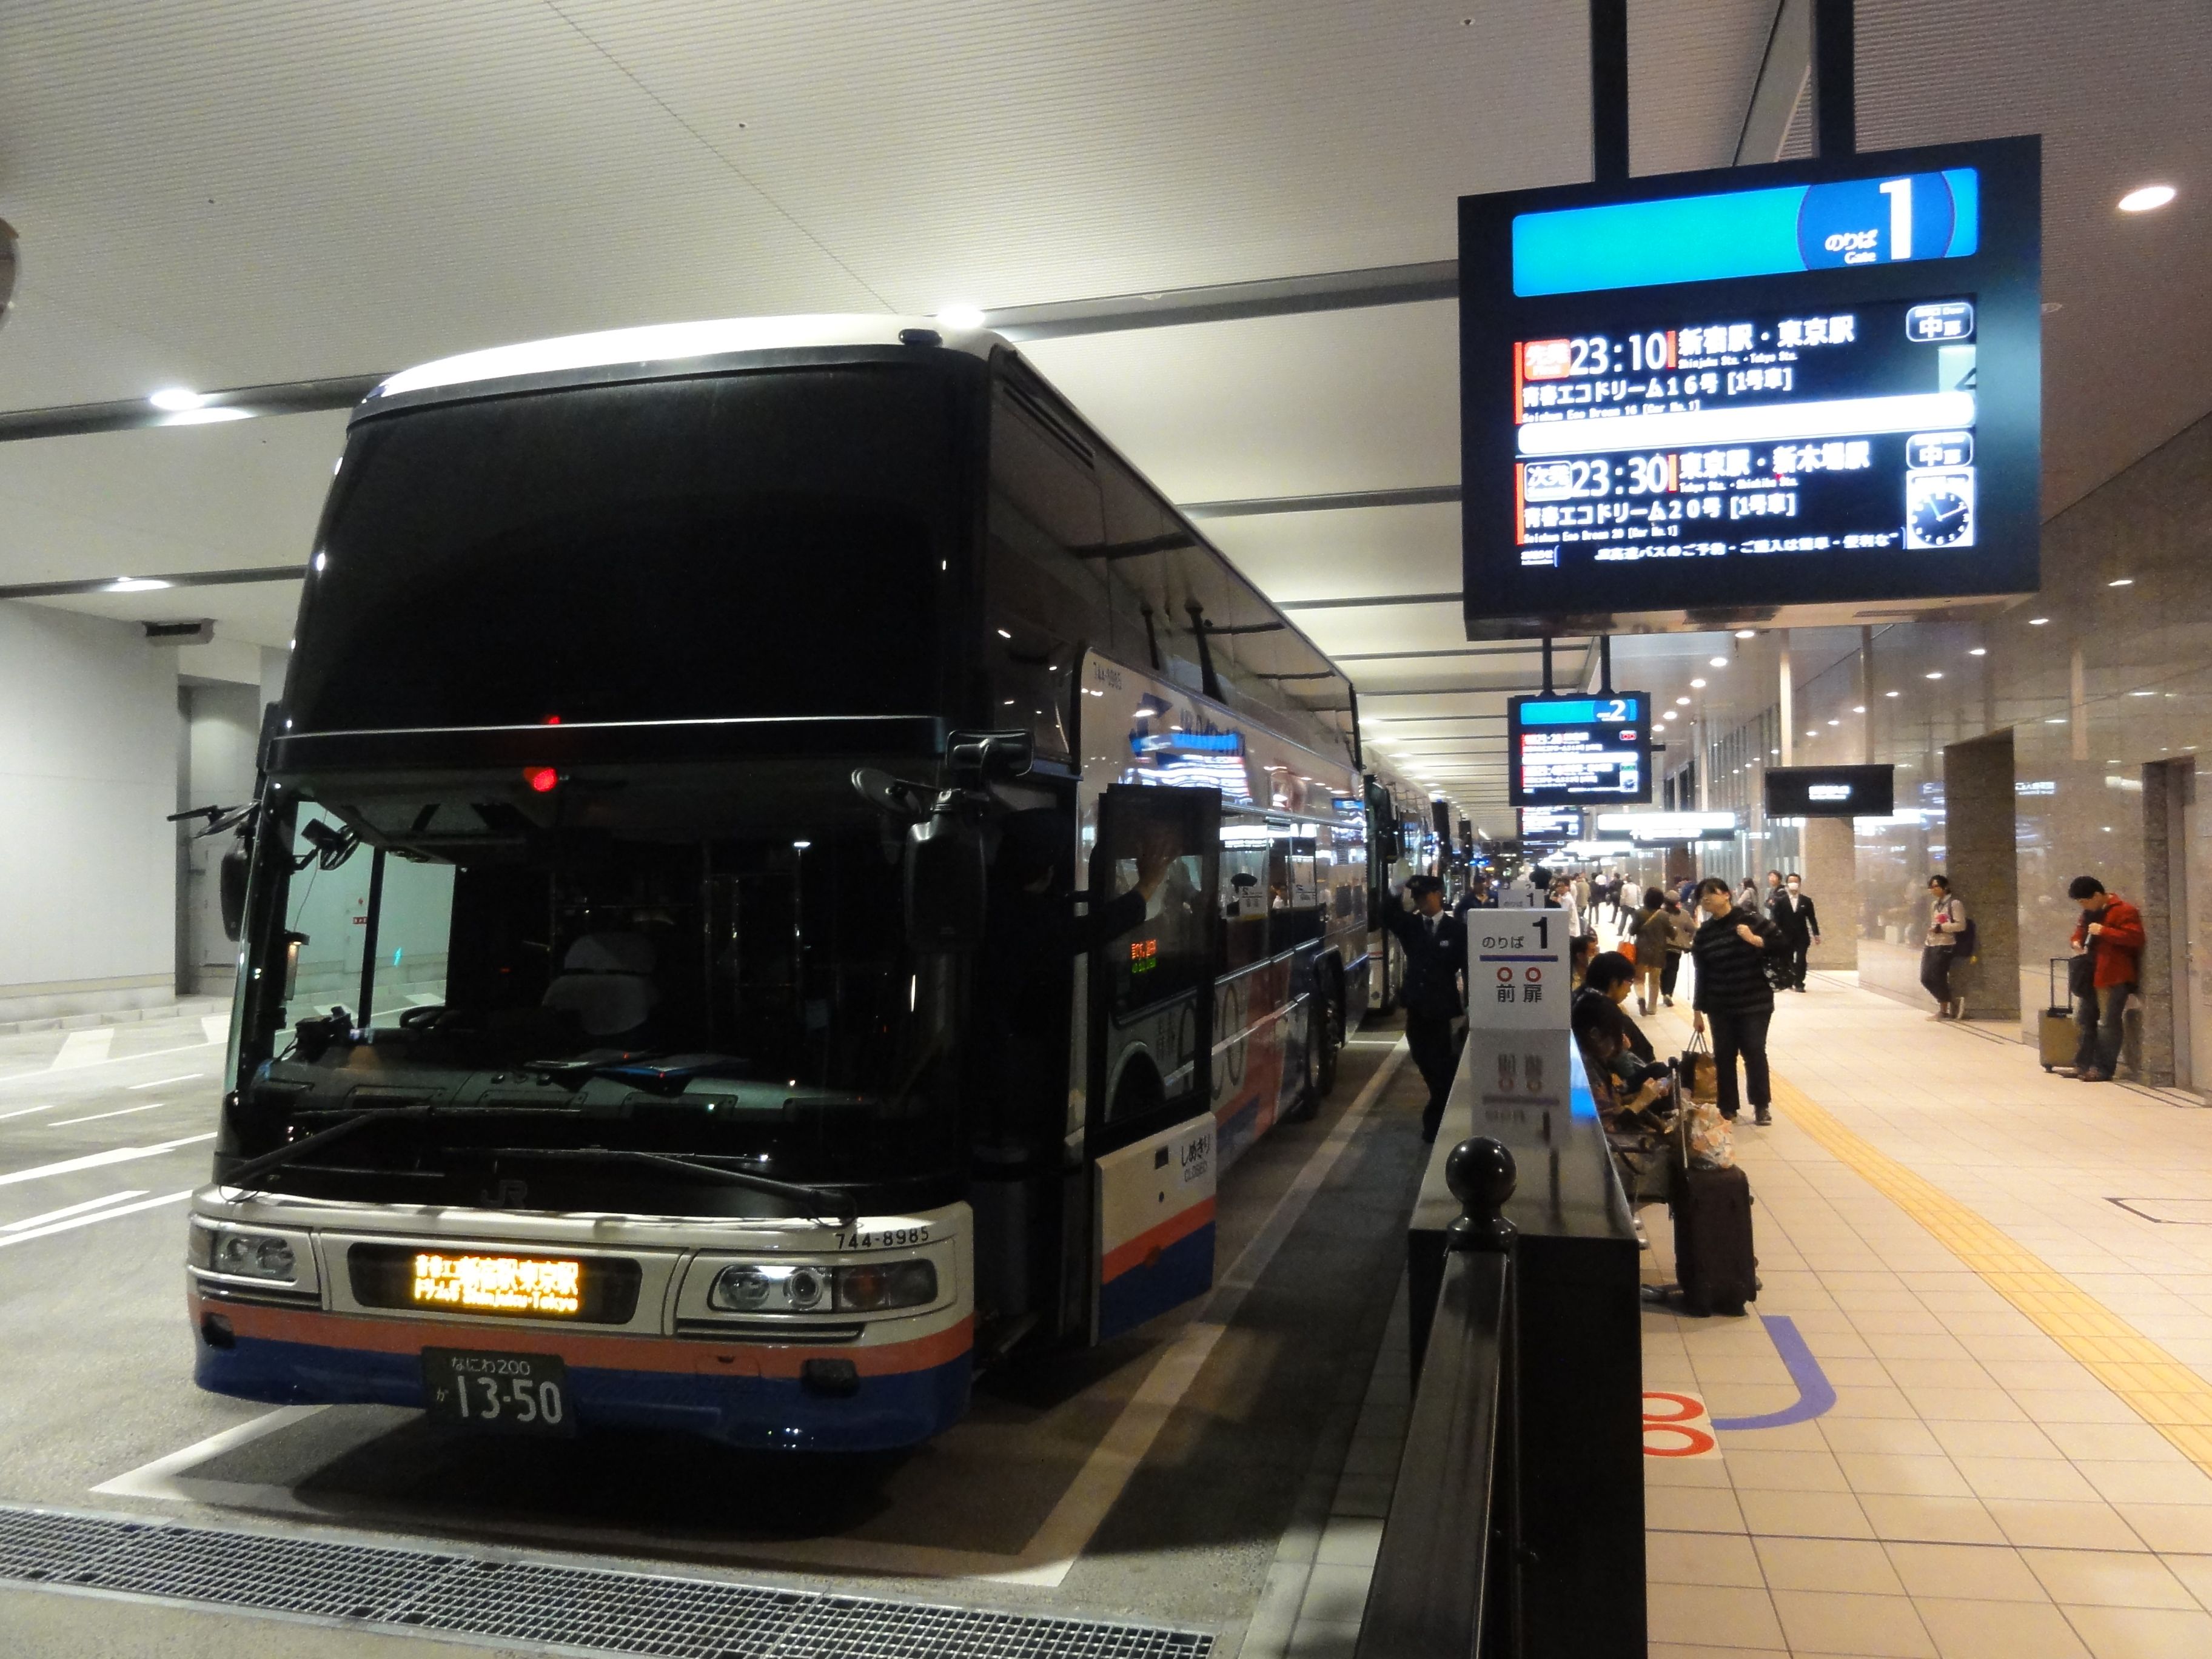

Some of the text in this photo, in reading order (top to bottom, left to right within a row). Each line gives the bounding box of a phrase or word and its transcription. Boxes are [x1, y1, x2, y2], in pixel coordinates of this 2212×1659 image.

[1825, 178, 1911, 260] のりば 1
[1845, 251, 1877, 264] Gate
[1569, 333, 1667, 377] 23:10
[1570, 455, 1669, 498] 23:30
[1610, 699, 1626, 721] 2
[1482, 916, 1548, 949] のりば 1
[835, 1226, 928, 1250] 744-8985
[457, 1375, 563, 1424] 13-50
